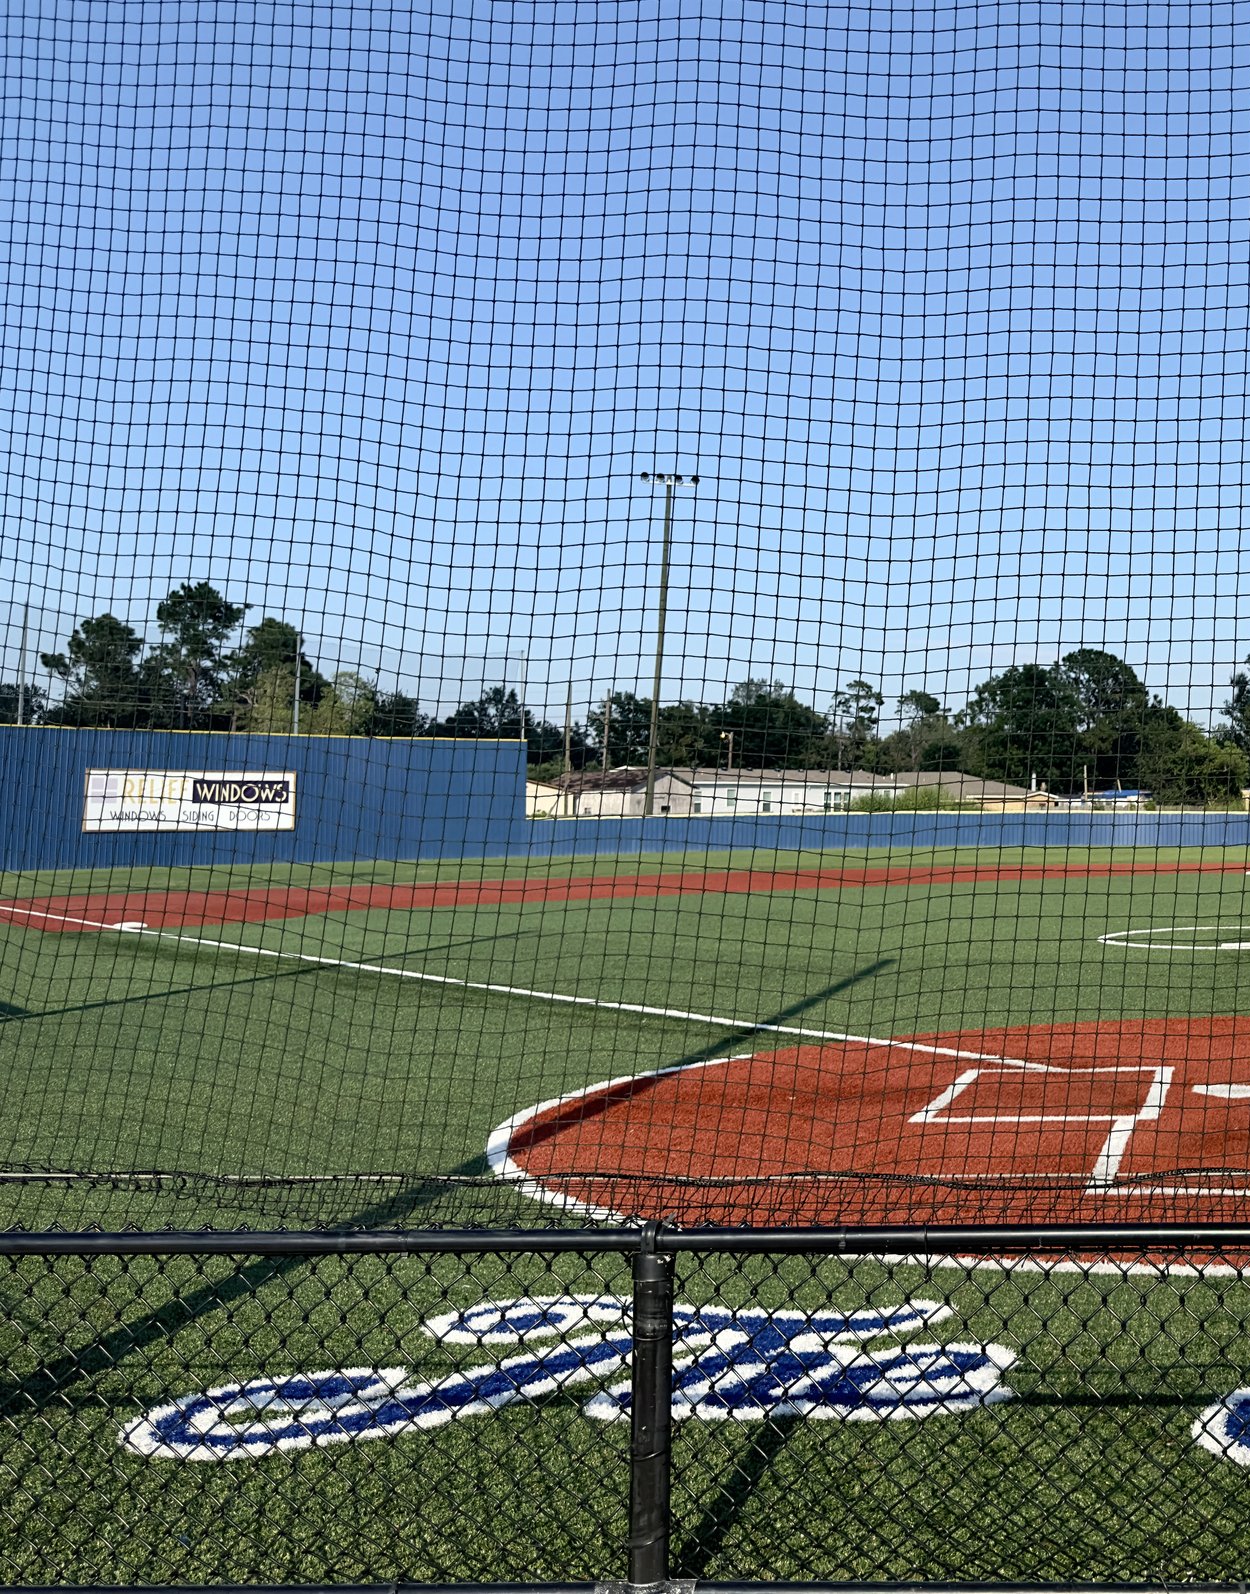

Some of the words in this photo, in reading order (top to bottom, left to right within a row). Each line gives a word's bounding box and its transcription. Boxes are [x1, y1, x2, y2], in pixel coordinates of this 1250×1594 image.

[196, 782, 288, 803] WINDOWS
[110, 810, 167, 822] WINDOWS
[182, 810, 215, 822] SIDING
[229, 810, 271, 822] DOORS
[119, 1294, 1021, 1460] The
